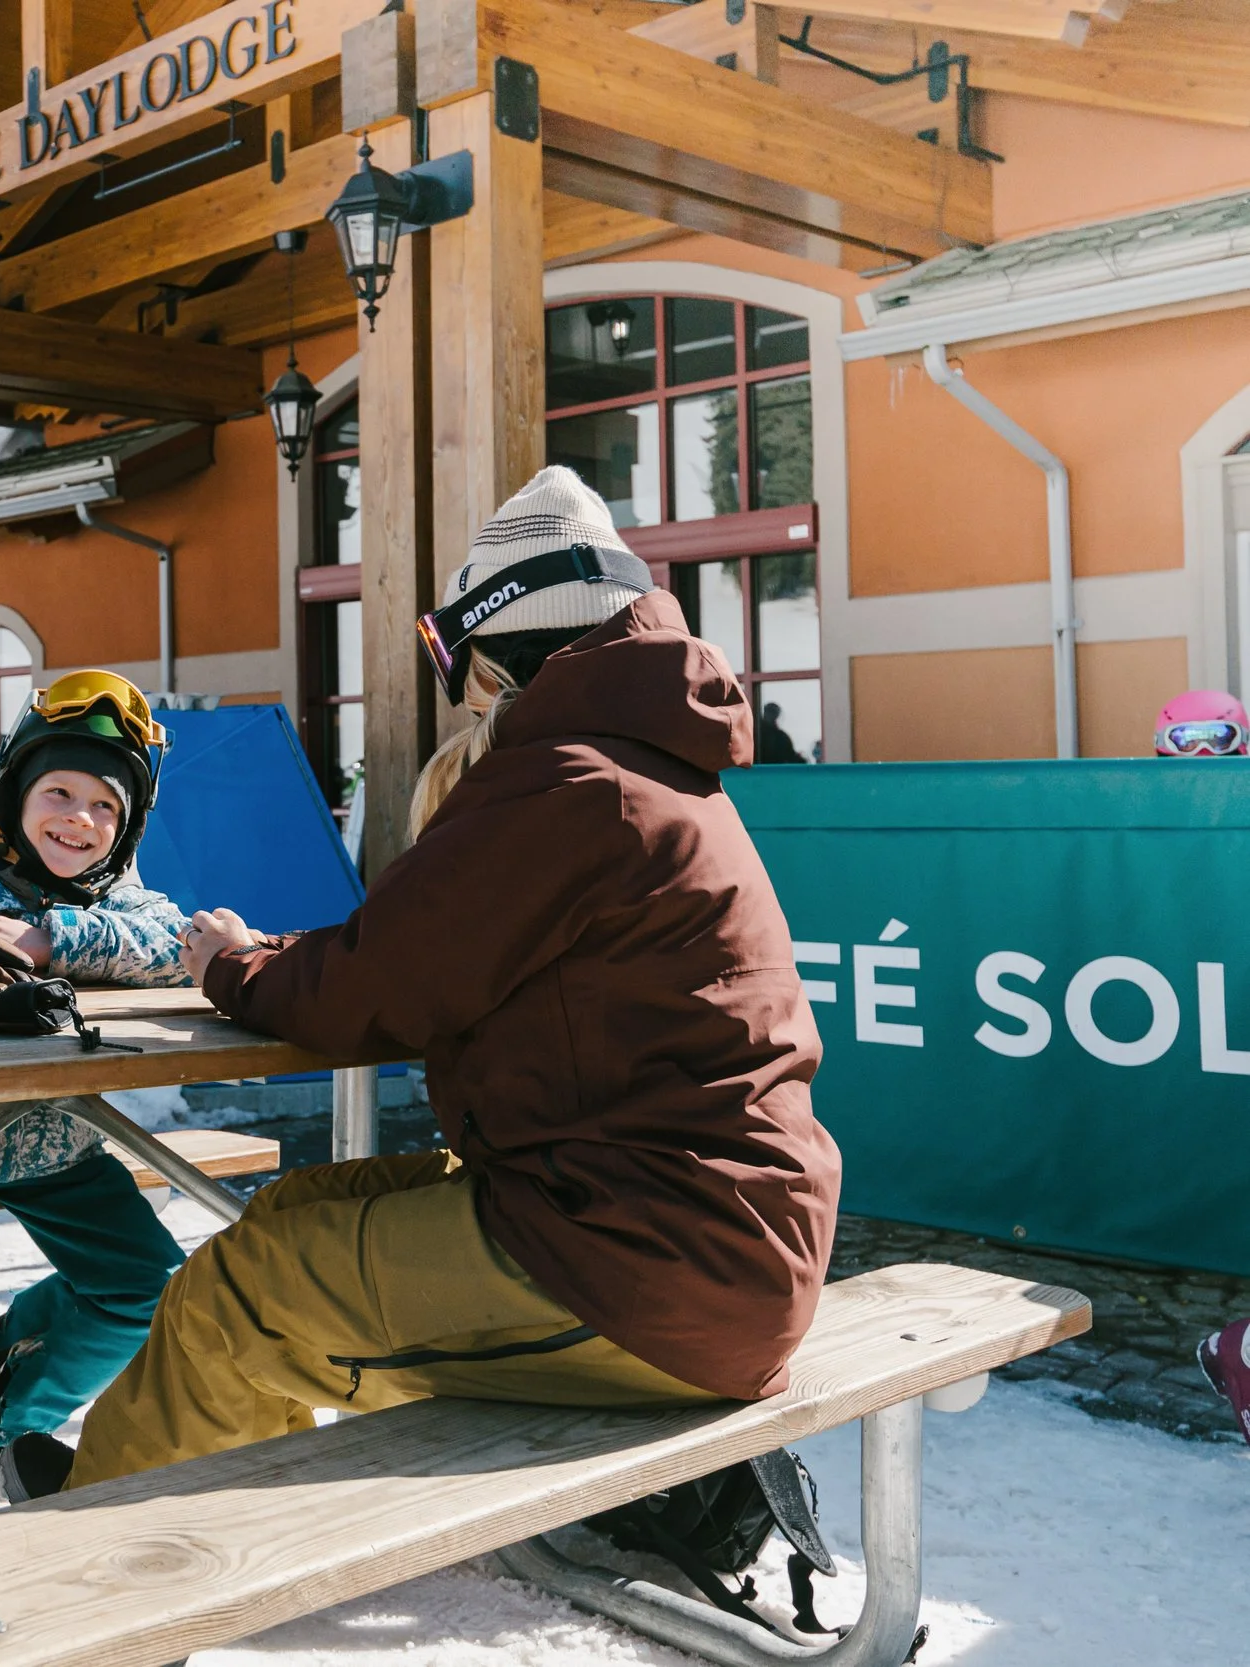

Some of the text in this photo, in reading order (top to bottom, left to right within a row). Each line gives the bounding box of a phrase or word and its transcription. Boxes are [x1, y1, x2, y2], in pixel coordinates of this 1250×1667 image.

[17, 0, 297, 171] DAYLODGE
[461, 581, 526, 630] anon.
[973, 950, 1250, 1076] SOL
